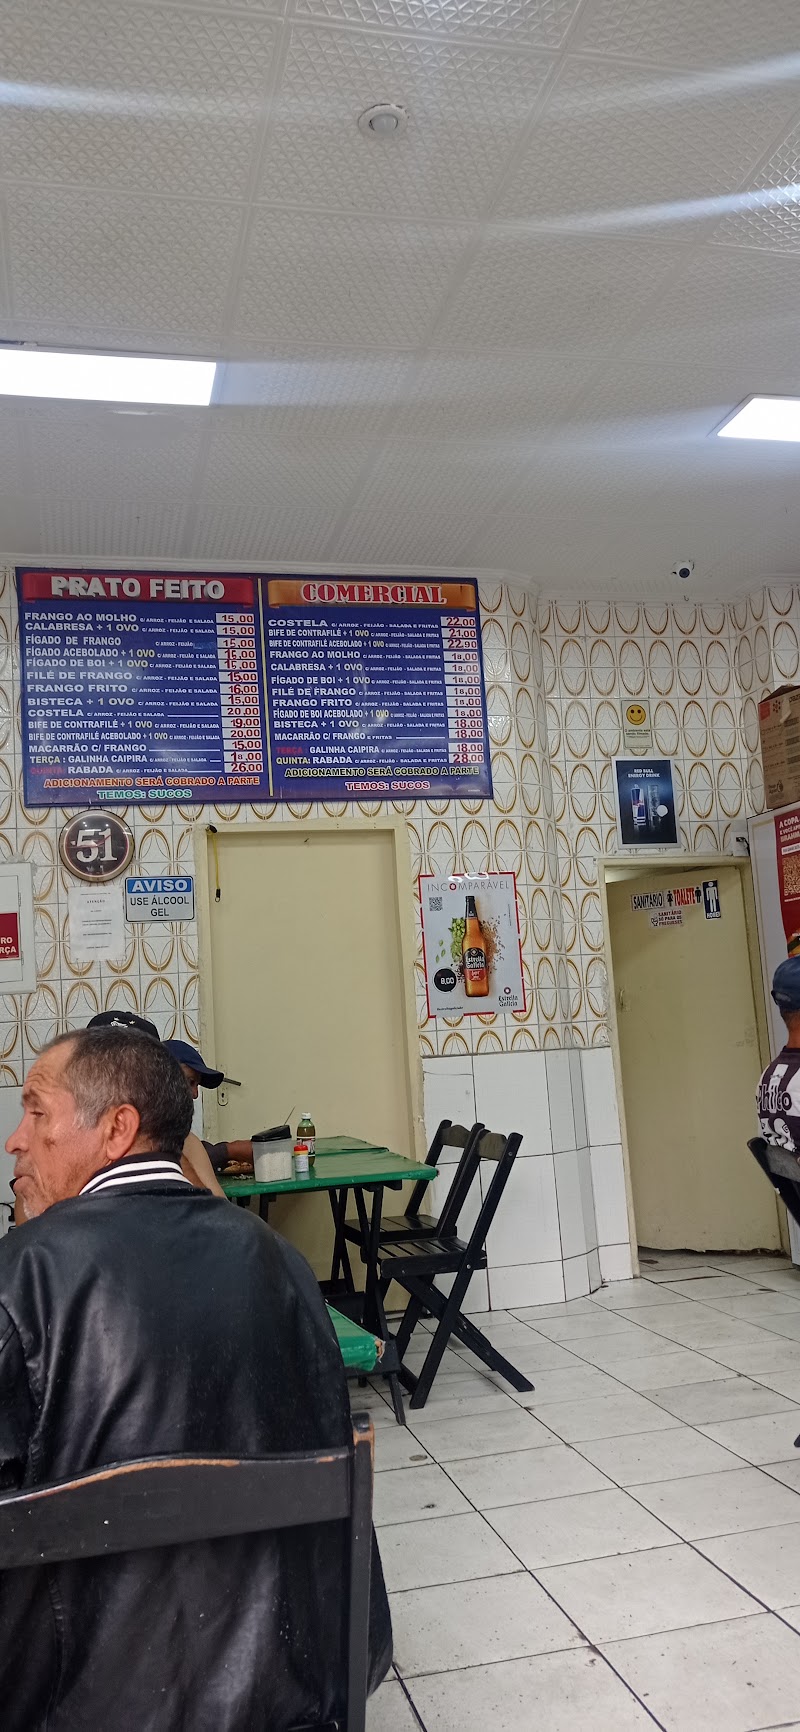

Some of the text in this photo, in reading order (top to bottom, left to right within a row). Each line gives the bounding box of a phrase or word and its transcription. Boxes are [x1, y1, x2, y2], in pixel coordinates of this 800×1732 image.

[51, 576, 225, 600] PRATO FEITO
[301, 583, 447, 604] COMERCIAL
[25, 612, 73, 620] FRANGO
[96, 614, 136, 622] MOLHO
[221, 614, 253, 623] 15,00
[25, 622, 93, 631] CALABRESA
[106, 624, 112, 632] 1
[116, 624, 139, 632] OVO
[223, 626, 254, 636] 15,00
[26, 634, 61, 644] FÍGADO
[66, 636, 78, 644] DE
[83, 636, 121, 646] FRANGO
[26, 646, 60, 656] FÍGADO
[63, 648, 118, 657] ACEBOLADO
[128, 649, 134, 657] 1
[136, 649, 155, 658] OVO
[26, 658, 66, 667] FÍGADO
[70, 659, 84, 667] DE
[87, 659, 106, 667] BOI
[126, 660, 148, 668] OVO
[26, 670, 257, 682] FILÉ DE FRANGO 15,00
[27, 684, 84, 692] FRANGO
[88, 684, 128, 692] FRITO
[229, 684, 257, 695] 16,00
[272, 686, 294, 696] FILÉ
[28, 698, 83, 706] BISTECA
[98, 698, 104, 706] 1
[108, 698, 134, 706] OVO
[228, 694, 258, 705] 15,00
[28, 709, 84, 717] COSTELA
[227, 708, 259, 716] 20,00
[64, 719, 118, 728] CONTRAFILÉ
[128, 720, 132, 728] 1
[135, 720, 152, 728] OVO
[230, 718, 259, 728] 19,00
[274, 732, 320, 740] MACARRÃO
[29, 743, 88, 752] MACARRÃO
[104, 744, 146, 752] FRANGO
[232, 740, 261, 750] 15,00
[68, 766, 113, 774] RABADA
[231, 762, 262, 772] 26,00
[284, 766, 480, 778] ADICIONAMENTO SERÁ COBRADO A PARTE
[44, 776, 260, 788] ADICIONAMENTO SERÁ COBRADO A PARTE
[345, 780, 430, 790] TEMOS: SUCOS
[97, 789, 192, 800] TEMOS: SUCOS
[784, 816, 799, 827] COPA
[76, 828, 118, 863] 51
[132, 880, 188, 892] AVISO
[427, 880, 510, 892] INCOMPARÁVEL
[130, 894, 190, 906] USE ÁLCOOL
[673, 888, 696, 906] TOALETE
[150, 908, 170, 917] GEL
[498, 994, 518, 1002] Estrella
